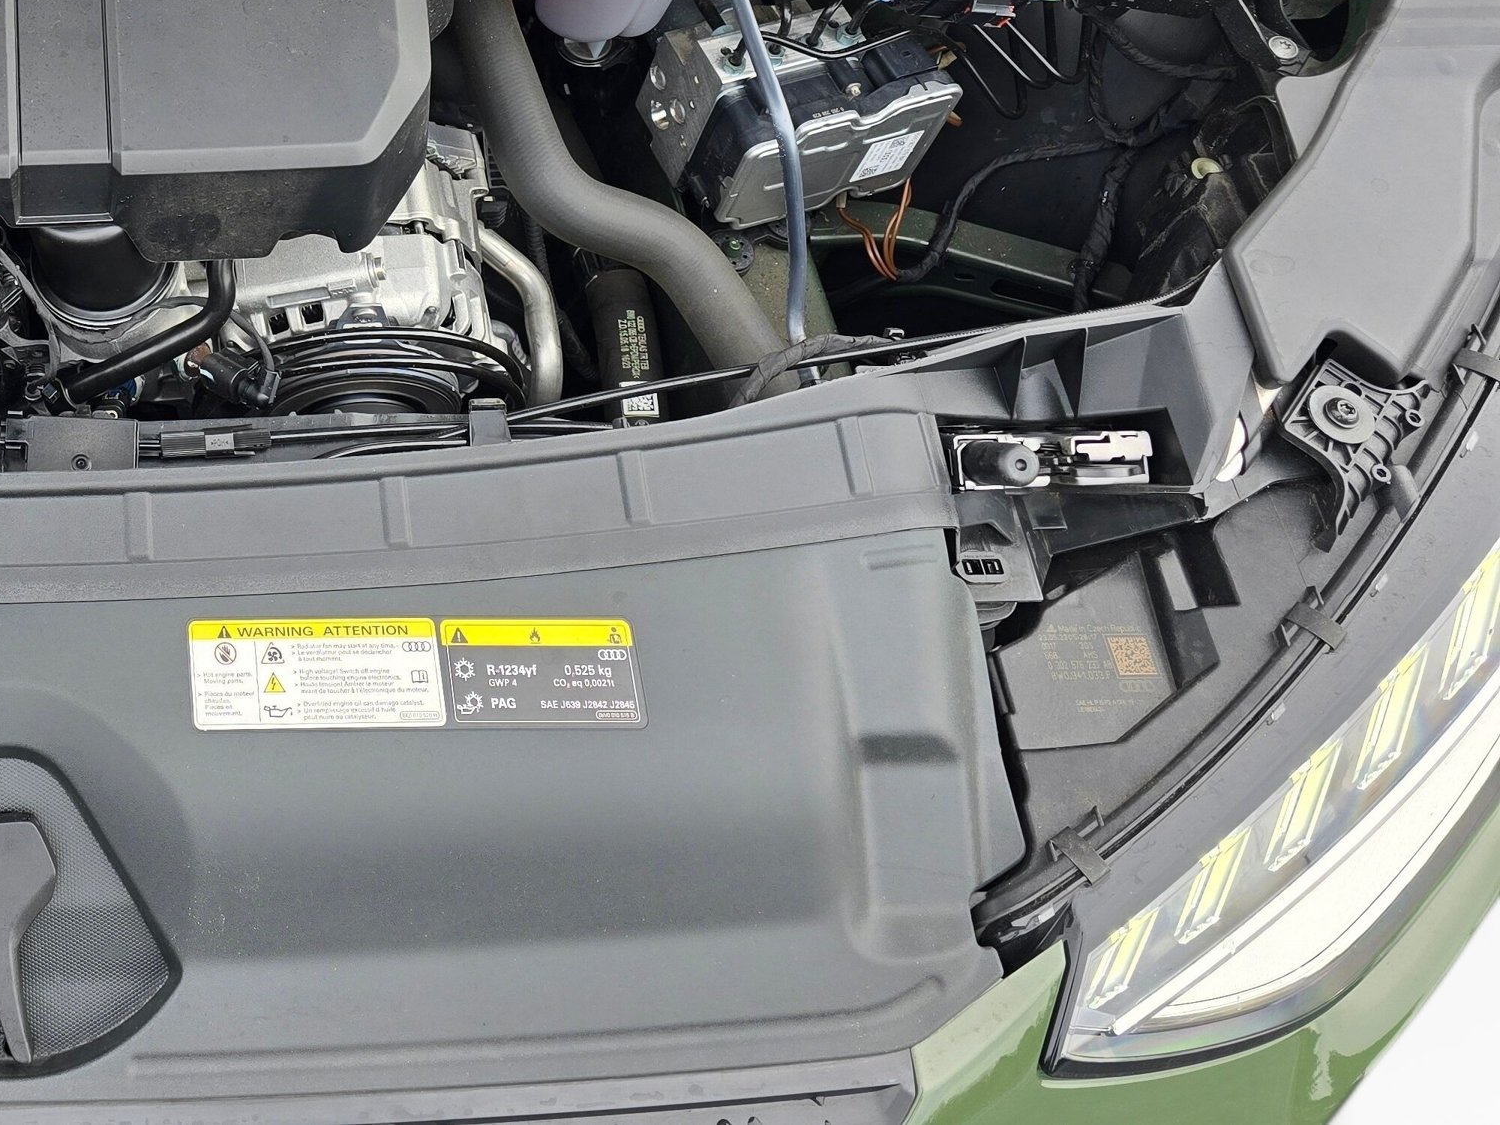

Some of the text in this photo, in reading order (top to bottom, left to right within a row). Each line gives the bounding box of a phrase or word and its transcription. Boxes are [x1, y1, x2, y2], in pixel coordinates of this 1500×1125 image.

[237, 625, 409, 638] WARNING ATTENTION
[1057, 625, 1079, 633] Made
[300, 669, 314, 677] High
[486, 664, 612, 678] R-1234yf 0,525 kg
[488, 679, 510, 687] GWP
[511, 679, 518, 687] 4
[571, 680, 583, 689] eq
[491, 698, 635, 709] PAG SAE J639 J2842 J2845
